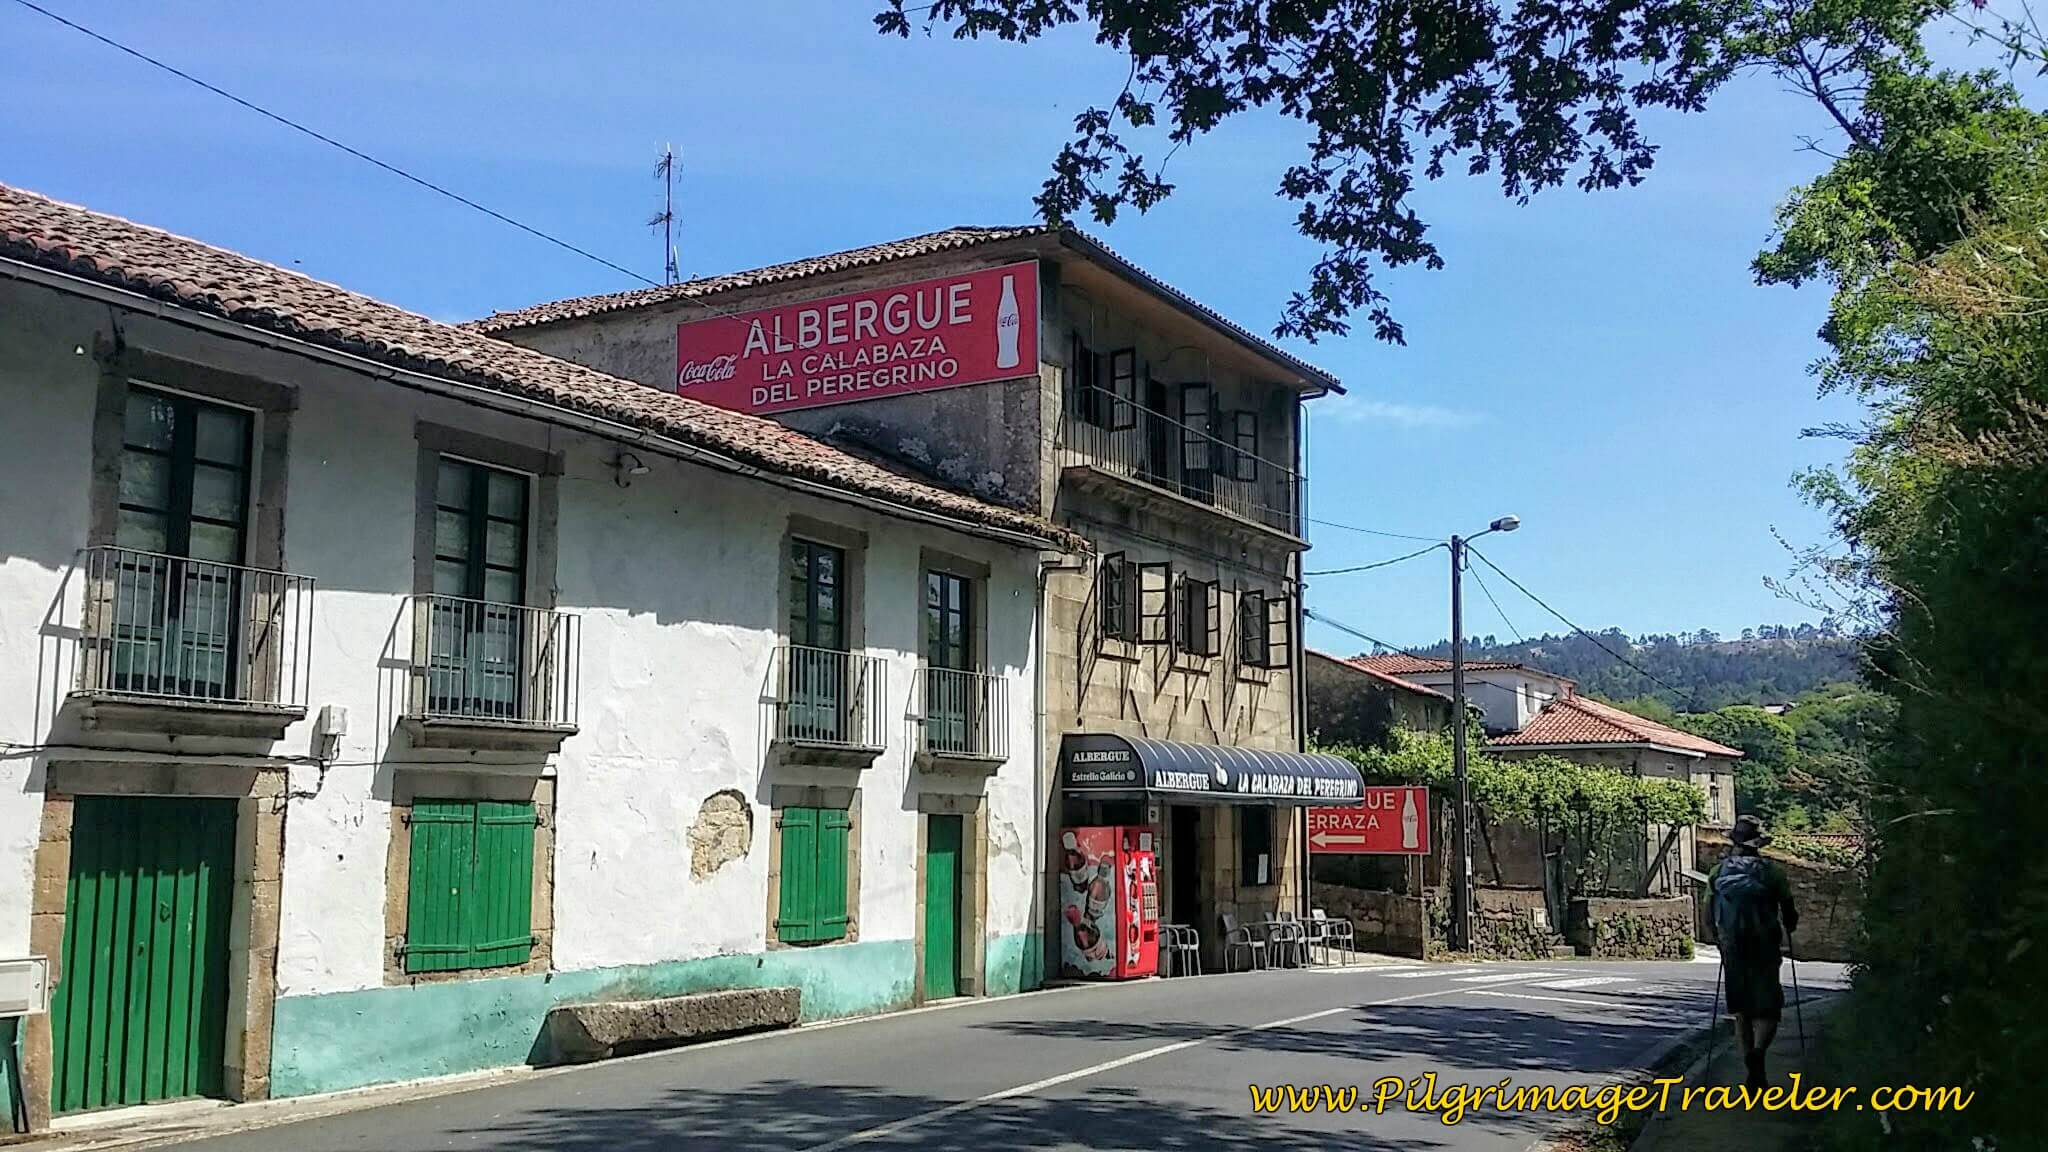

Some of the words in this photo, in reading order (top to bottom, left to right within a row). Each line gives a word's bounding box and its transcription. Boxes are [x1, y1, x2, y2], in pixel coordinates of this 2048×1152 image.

[743, 283, 972, 359] ALBERGUE
[763, 360, 794, 381] LA
[802, 336, 946, 374] CALABAZA
[752, 383, 798, 405] DEL
[807, 359, 958, 397] PEREGRINO
[1073, 751, 1130, 762] ALBERGUE
[1072, 771, 1099, 781] Estrella
[1100, 771, 1126, 781] Galicia
[1155, 771, 1210, 790] ALBERGUE
[1238, 772, 1249, 792] LA
[1251, 774, 1294, 794] CALABAZA
[1296, 775, 1313, 795] DEL
[1314, 776, 1358, 798] PEREGRINO
[1308, 814, 1380, 829] ERRAZA
